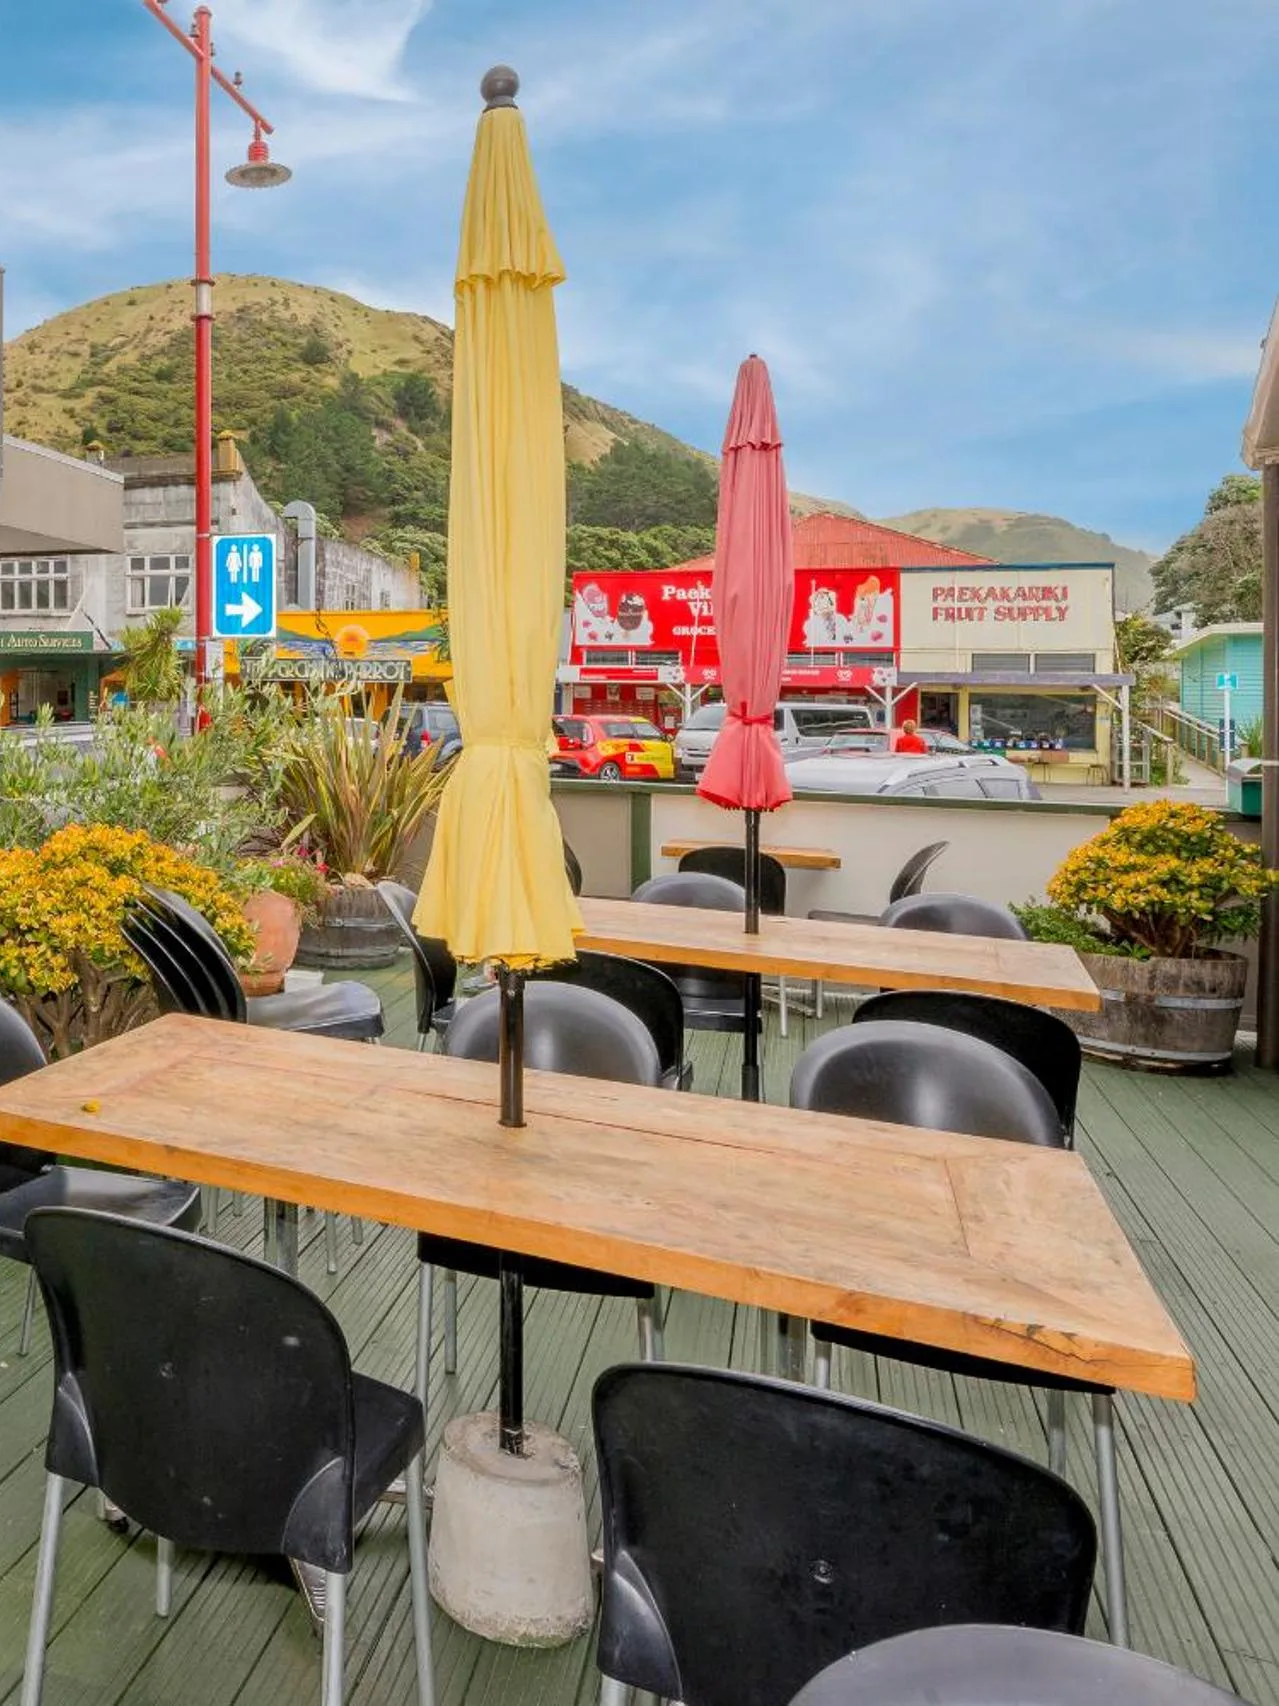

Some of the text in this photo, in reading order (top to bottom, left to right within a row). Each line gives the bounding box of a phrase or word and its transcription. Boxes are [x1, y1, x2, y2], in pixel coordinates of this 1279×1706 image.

[661, 584, 713, 600] Paek
[932, 585, 1069, 603] PAEKAKARIKI
[932, 606, 1070, 622] FRUIT SUPPLY
[672, 626, 717, 636] GROCE
[344, 660, 407, 681] PARROT
